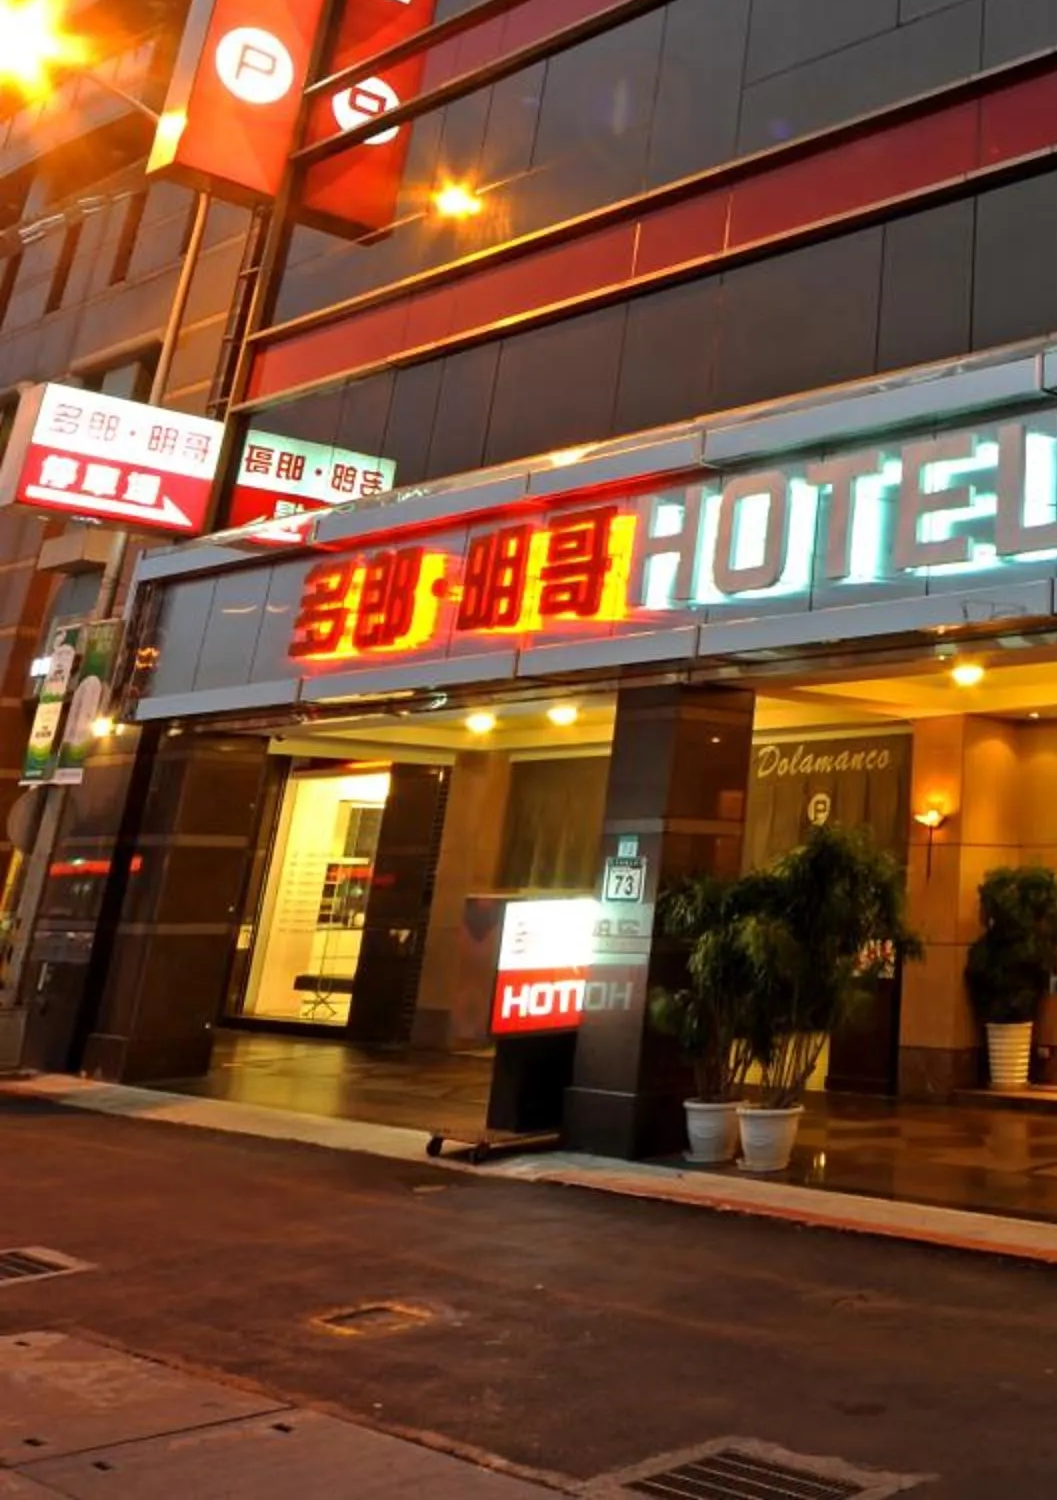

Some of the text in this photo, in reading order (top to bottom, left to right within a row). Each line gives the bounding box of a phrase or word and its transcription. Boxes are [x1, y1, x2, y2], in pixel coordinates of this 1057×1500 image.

[757, 744, 891, 779] Dolamanco
[614, 875, 634, 896] 73
[502, 980, 586, 1019] HOT
